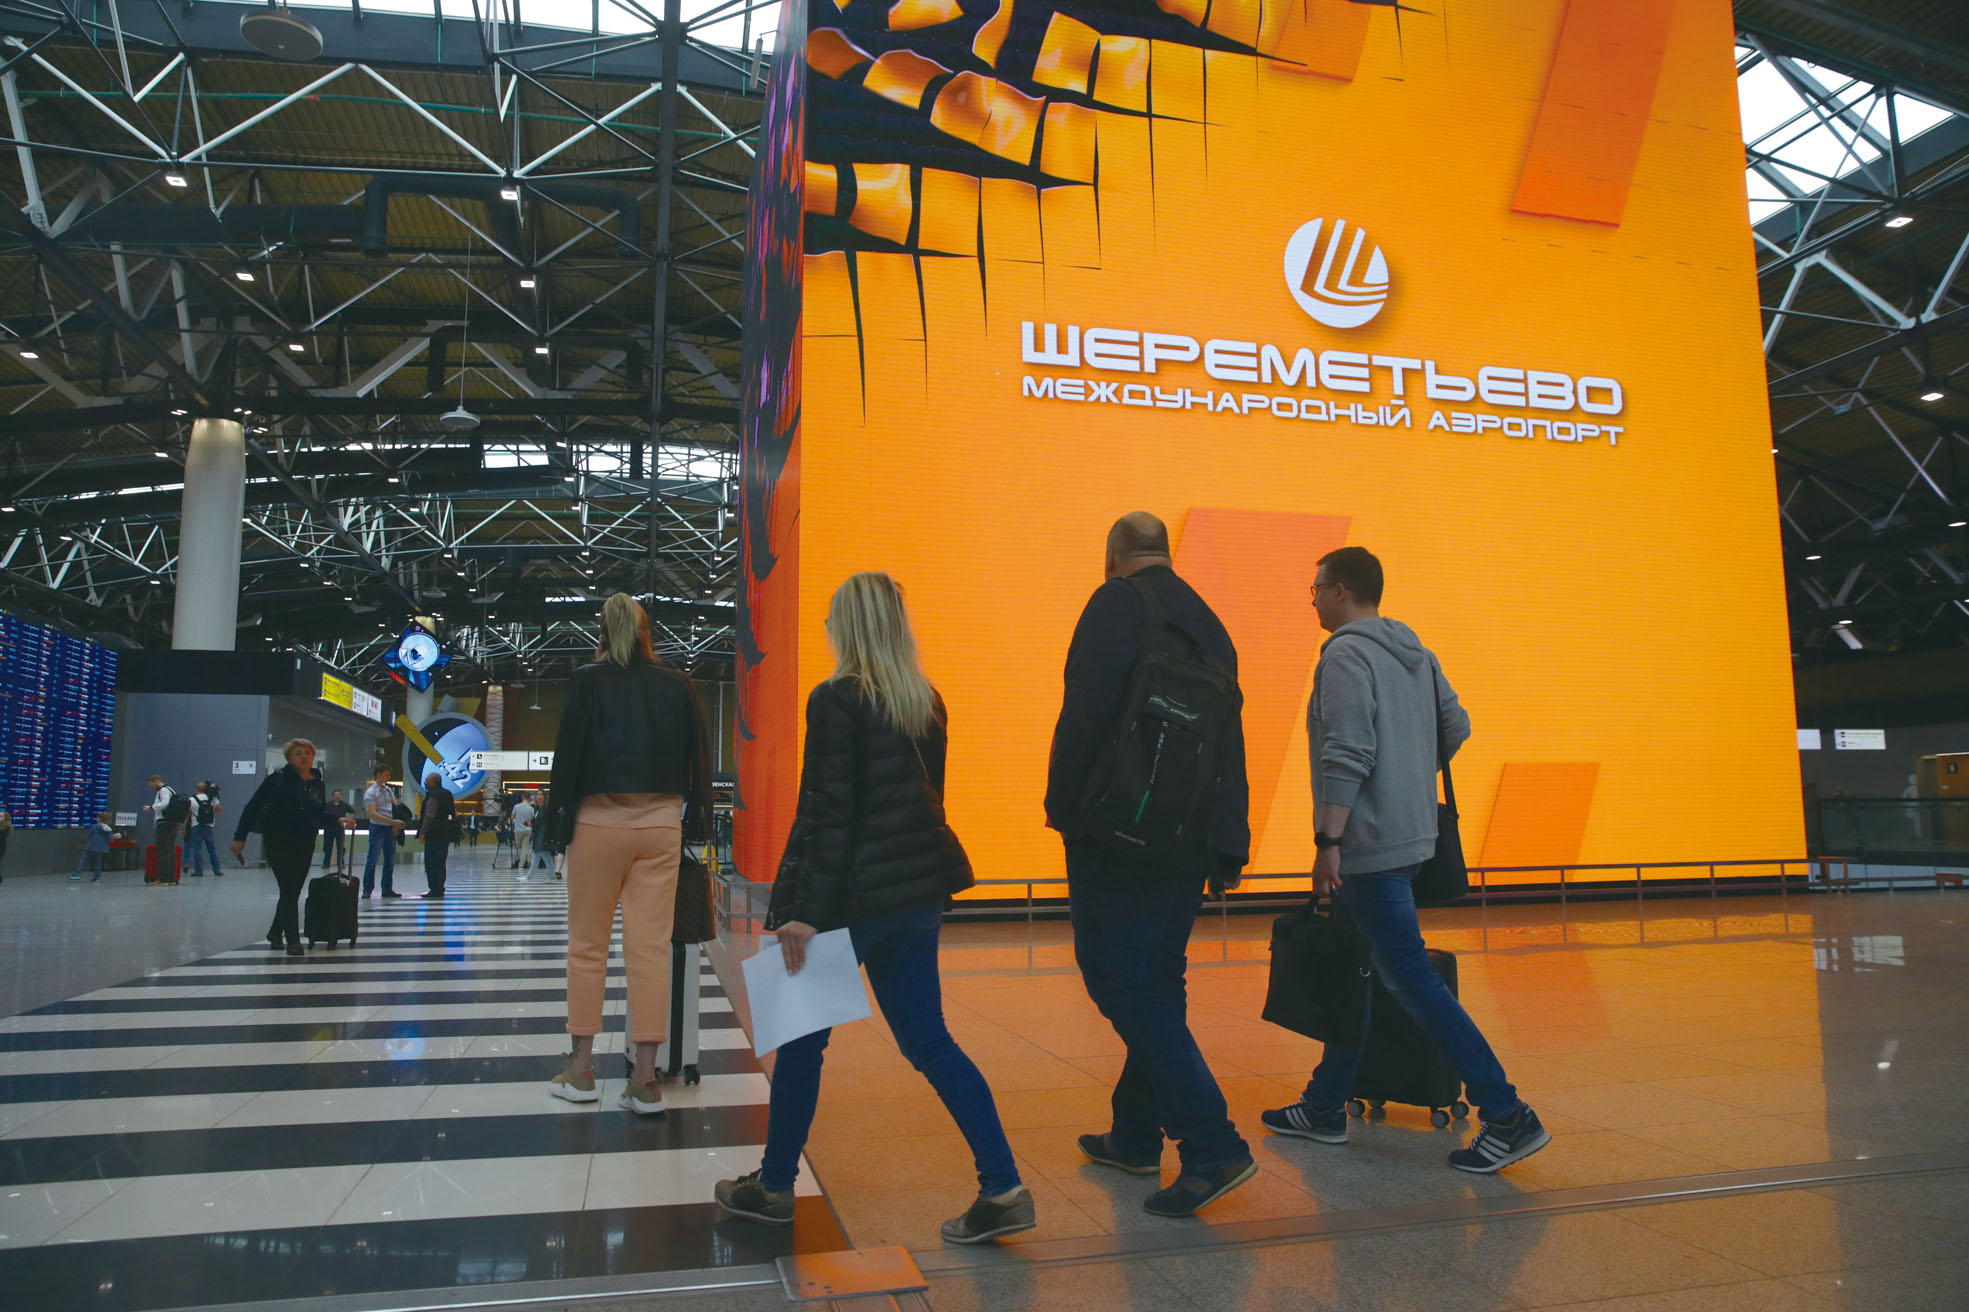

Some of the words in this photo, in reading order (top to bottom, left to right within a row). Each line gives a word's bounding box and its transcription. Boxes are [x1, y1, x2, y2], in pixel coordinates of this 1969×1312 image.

[1021, 320, 1623, 415] ШЕРЕМЕТЬЕВО
[1022, 375, 1412, 428] МЕЖДУНАРОДНЫЙ
[1427, 410, 1624, 446] АЭРОПОРТ
